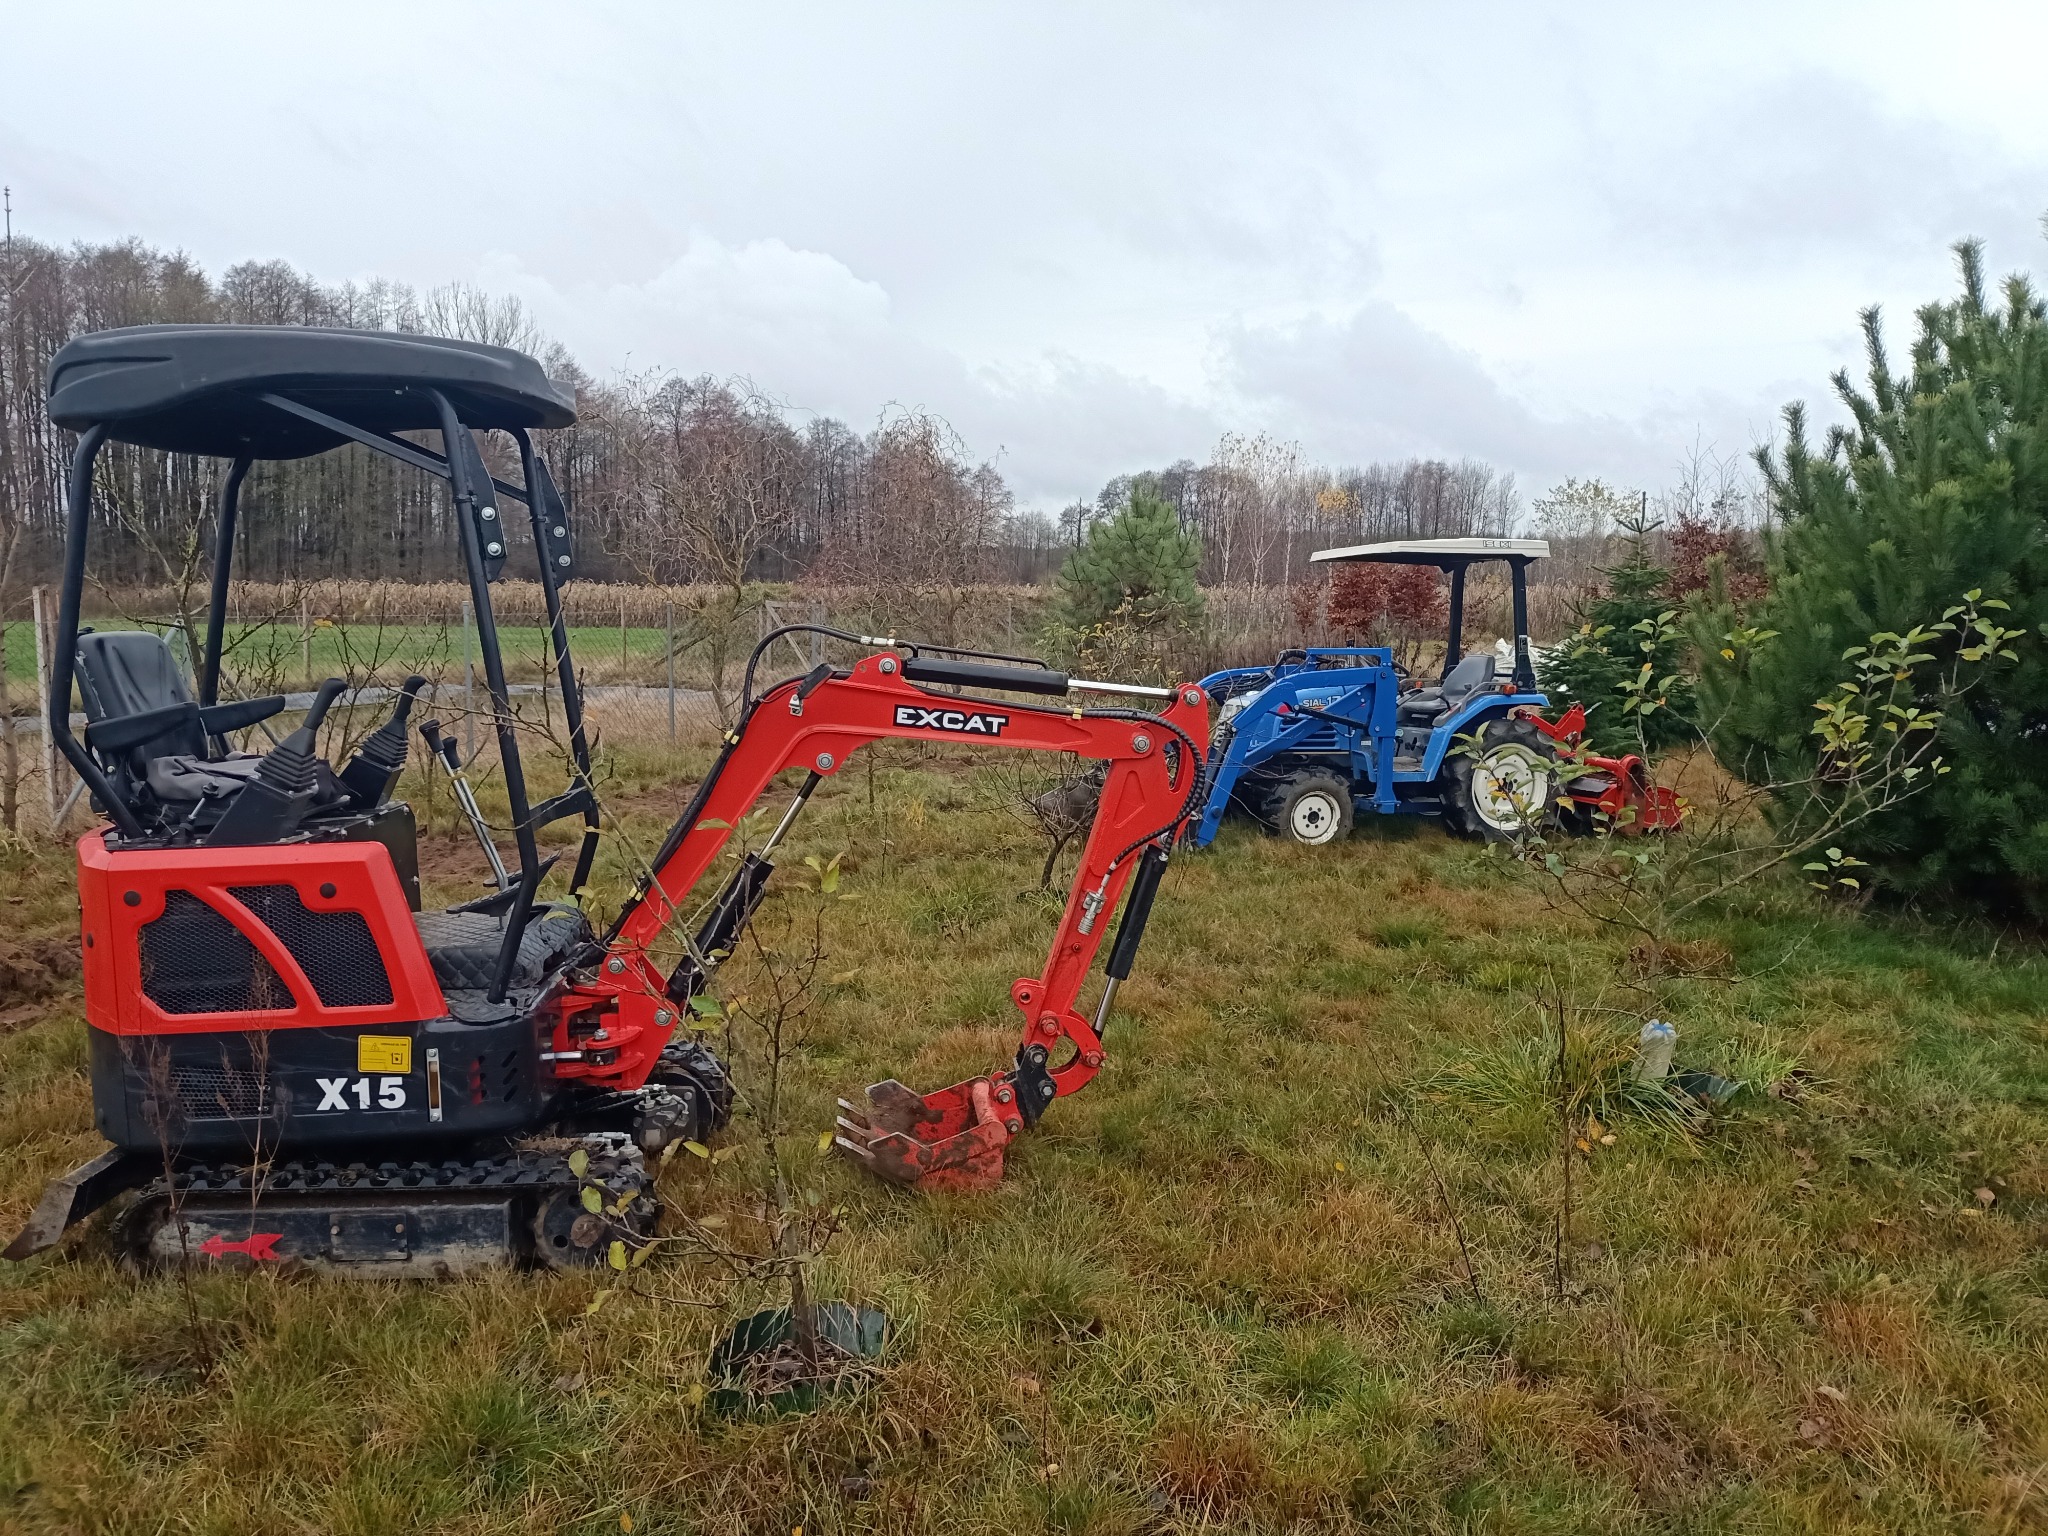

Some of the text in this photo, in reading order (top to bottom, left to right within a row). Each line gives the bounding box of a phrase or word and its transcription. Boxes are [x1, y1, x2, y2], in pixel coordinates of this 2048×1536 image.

[1303, 699, 1326, 707] SIAL
[896, 707, 1006, 733] EXCAT
[315, 1077, 407, 1111] X15
